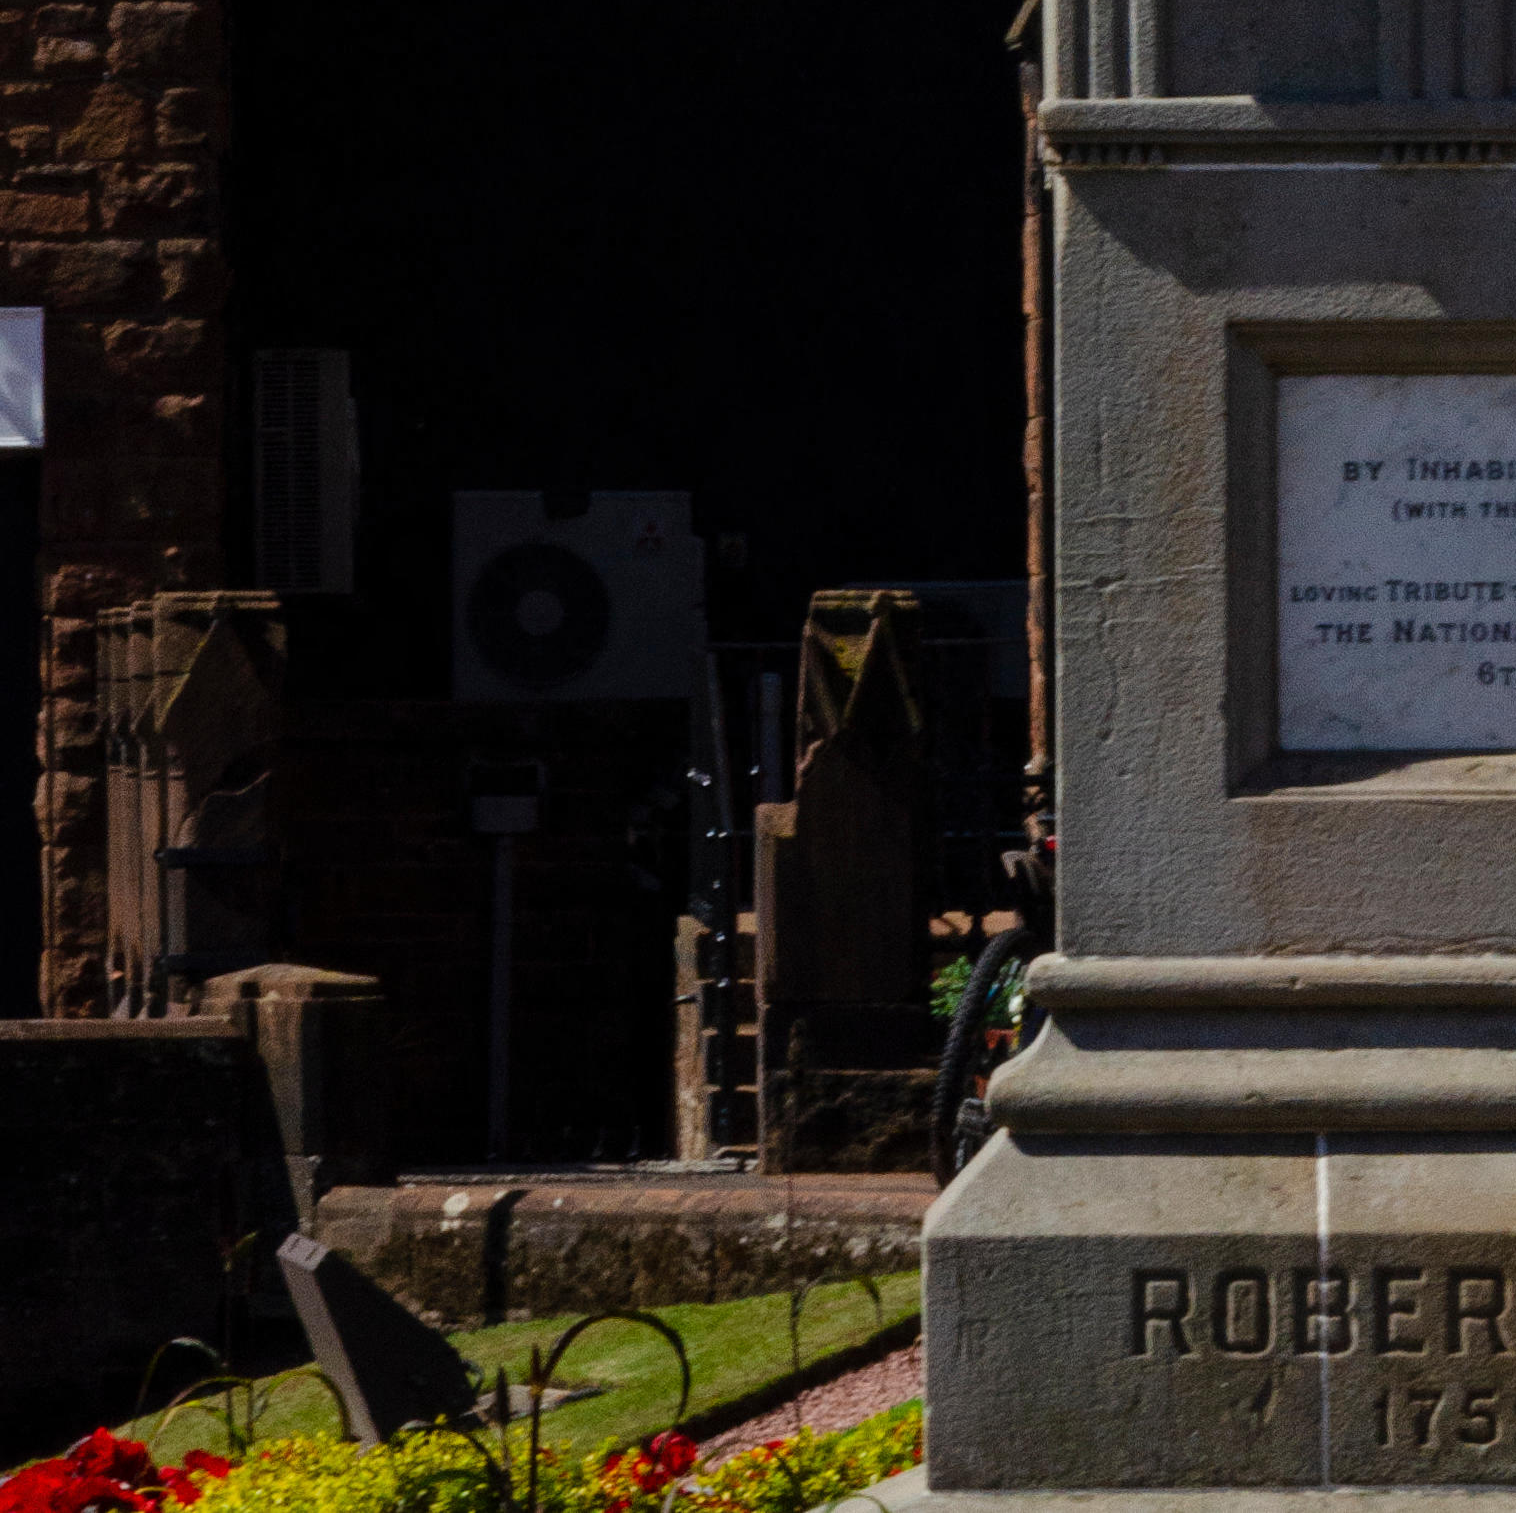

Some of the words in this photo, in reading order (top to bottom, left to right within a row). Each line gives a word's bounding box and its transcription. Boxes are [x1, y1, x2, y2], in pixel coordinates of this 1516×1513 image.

[1340, 458, 1388, 483] BY
[1390, 498, 1469, 524] (WITH
[1382, 577, 1508, 604] TRIBUTE
[1314, 621, 1375, 646] THE
